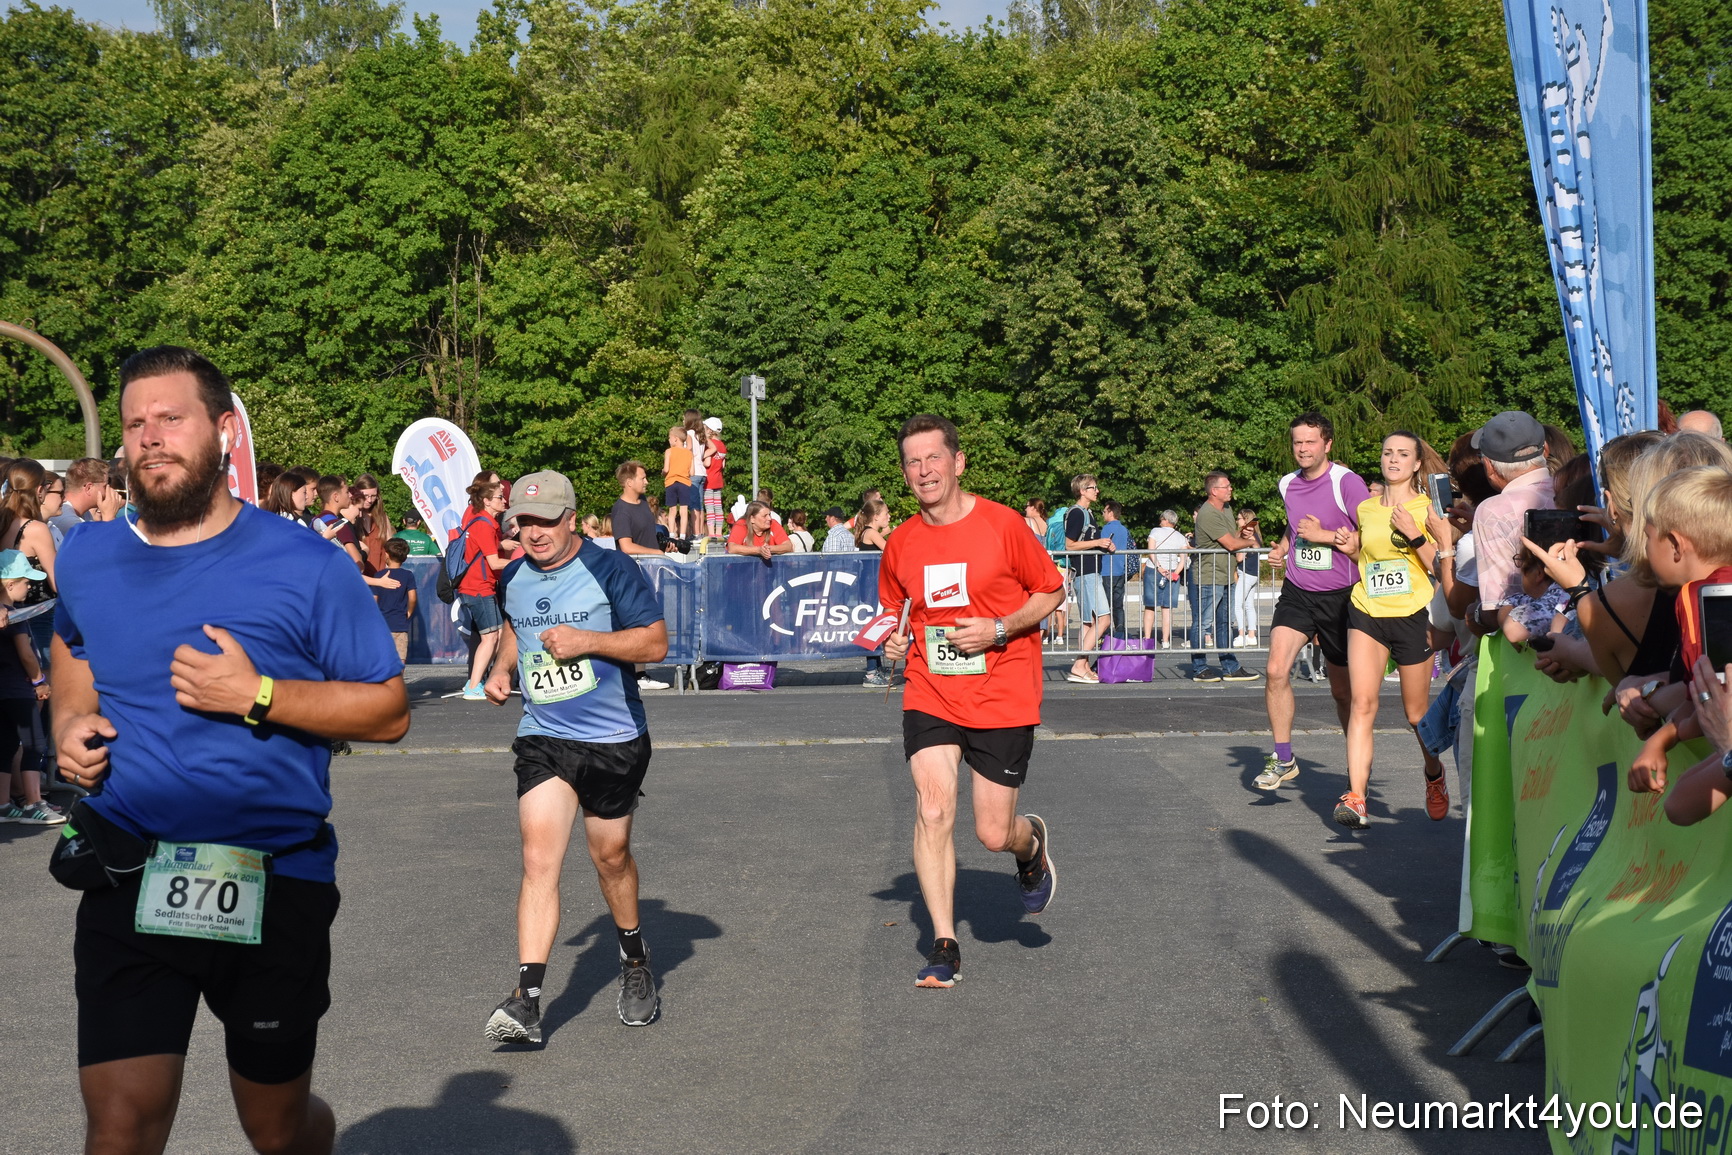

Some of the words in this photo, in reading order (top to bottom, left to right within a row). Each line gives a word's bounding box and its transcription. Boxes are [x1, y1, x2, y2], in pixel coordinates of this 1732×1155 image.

[1301, 548, 1321, 561] 630
[1371, 572, 1404, 587] 1763
[511, 611, 589, 629] CHABMÜLLER
[531, 662, 583, 690] 2118
[166, 875, 239, 914] 870
[155, 908, 214, 923] Sedlatschek
[216, 914, 245, 926] Daniel
[168, 919, 183, 927] Fritz
[184, 919, 207, 930] Berger
[208, 922, 230, 932] GmbH
[1714, 921, 1732, 958] Fis
